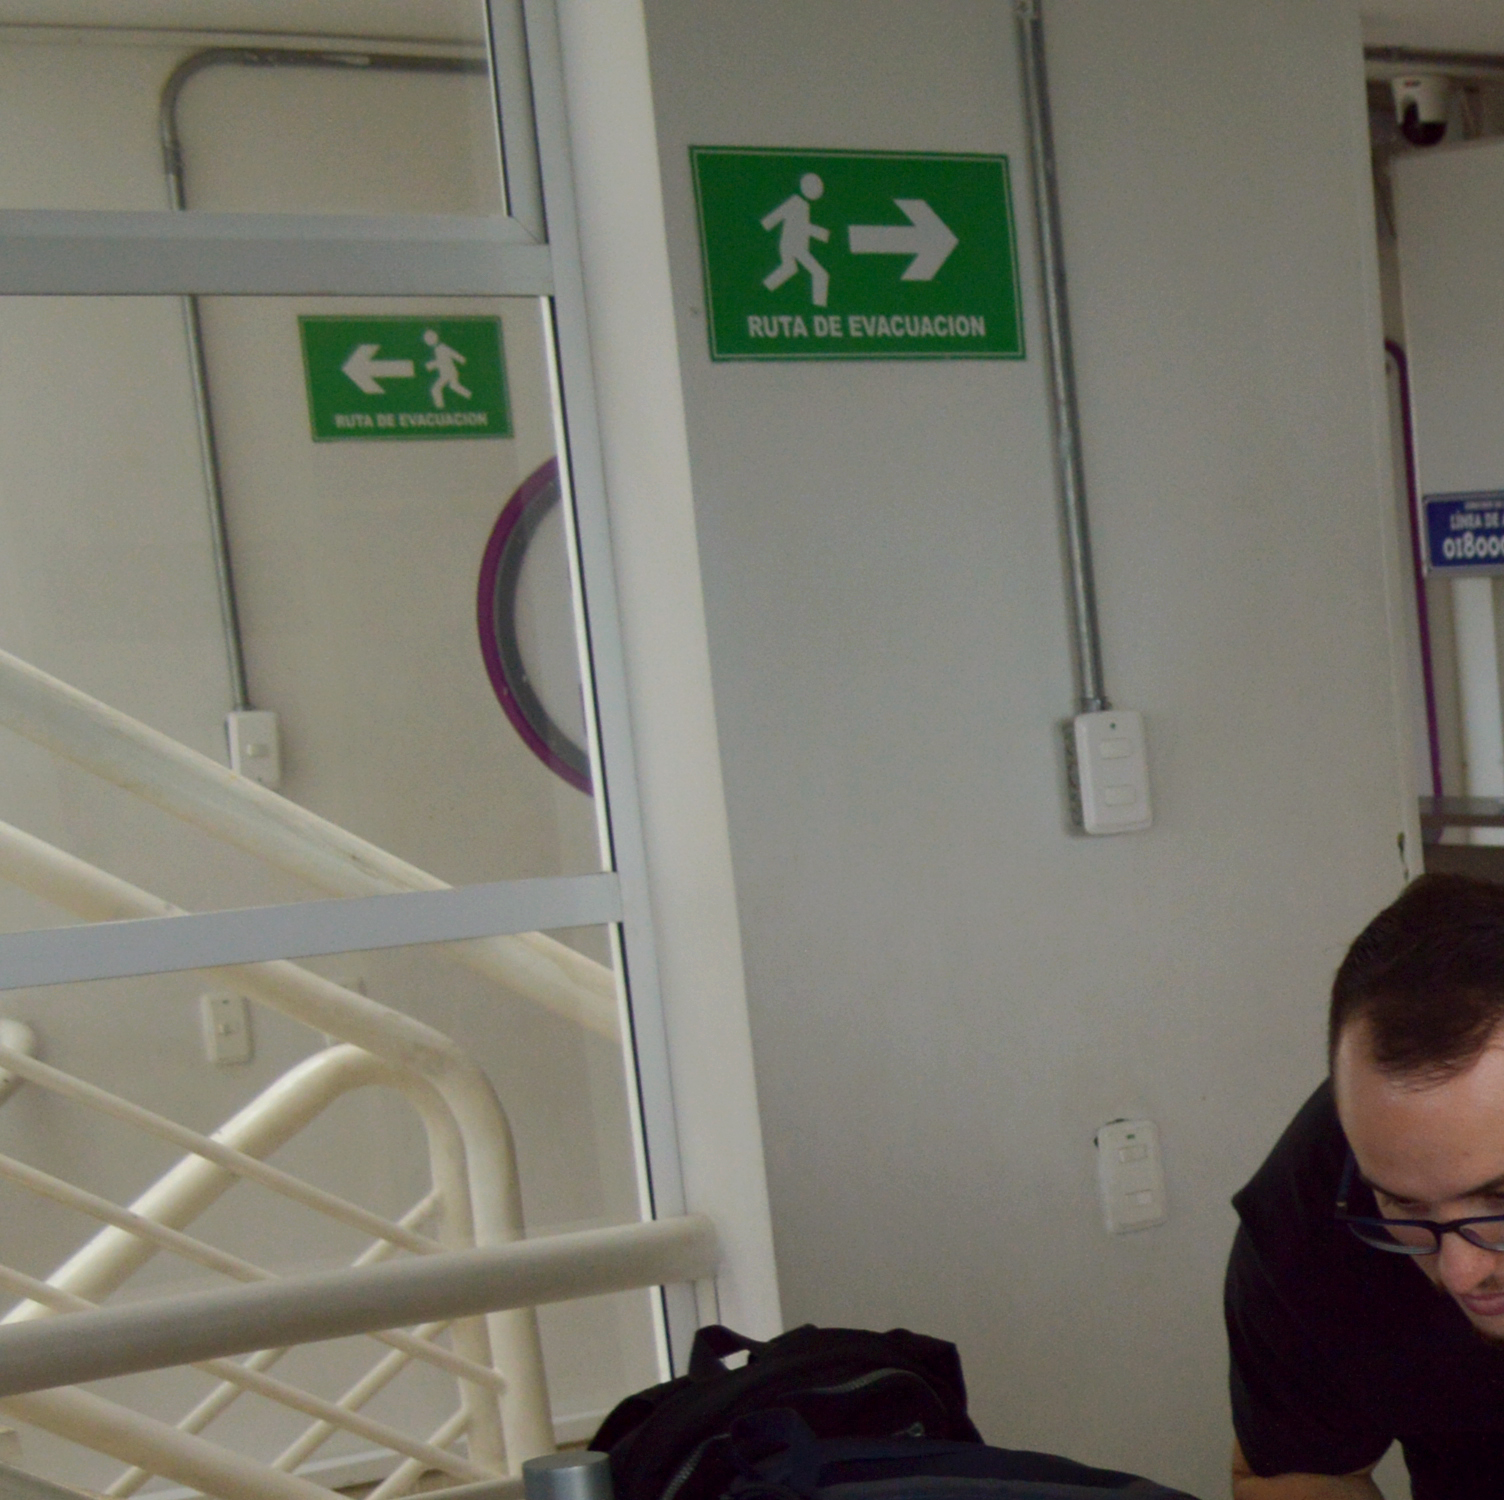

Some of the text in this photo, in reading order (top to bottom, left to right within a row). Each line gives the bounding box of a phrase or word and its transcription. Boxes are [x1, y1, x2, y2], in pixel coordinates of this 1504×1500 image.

[747, 315, 987, 338] RUTA DE EVACUACION
[335, 411, 488, 428] RUTA DE EVACUACION
[1485, 511, 1500, 528] DE
